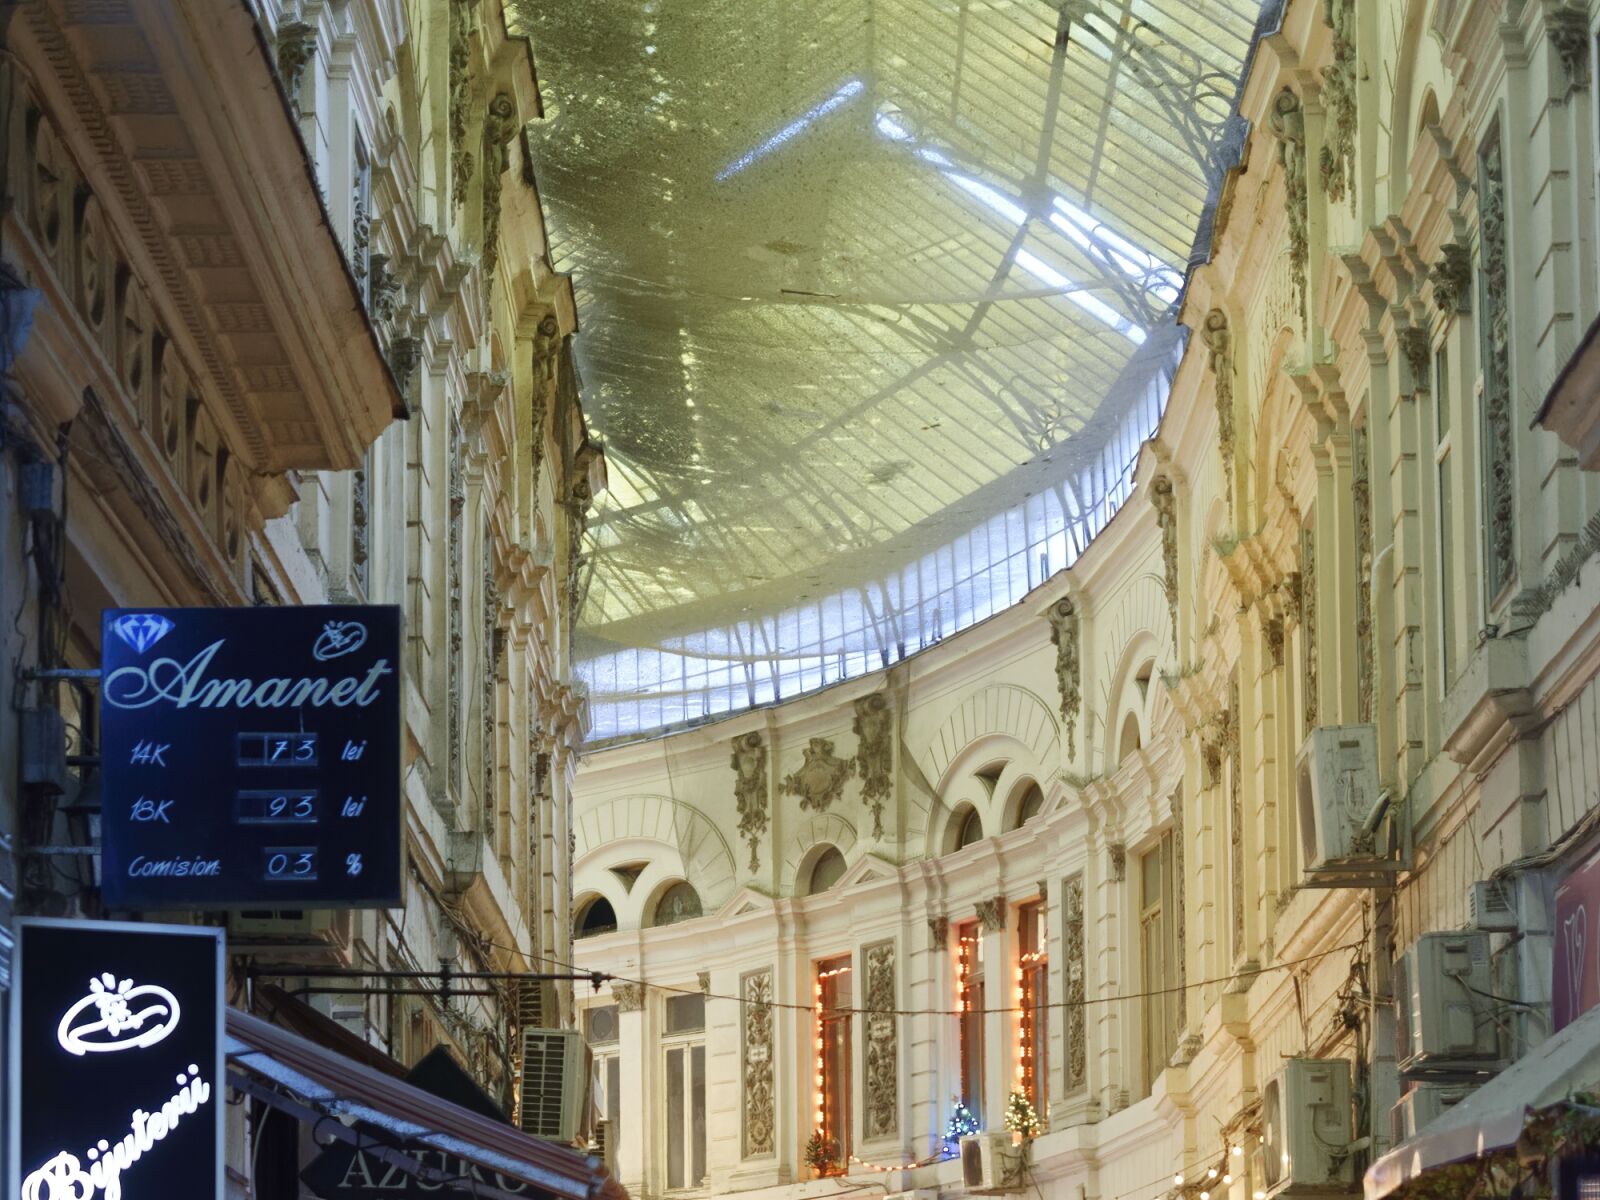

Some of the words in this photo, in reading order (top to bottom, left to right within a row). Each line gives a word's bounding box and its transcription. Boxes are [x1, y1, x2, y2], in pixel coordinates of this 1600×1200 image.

[103, 638, 392, 709] Amanet
[129, 739, 170, 767] 14K
[341, 739, 368, 761] lei
[129, 793, 174, 823] 18K
[341, 795, 368, 818] lei
